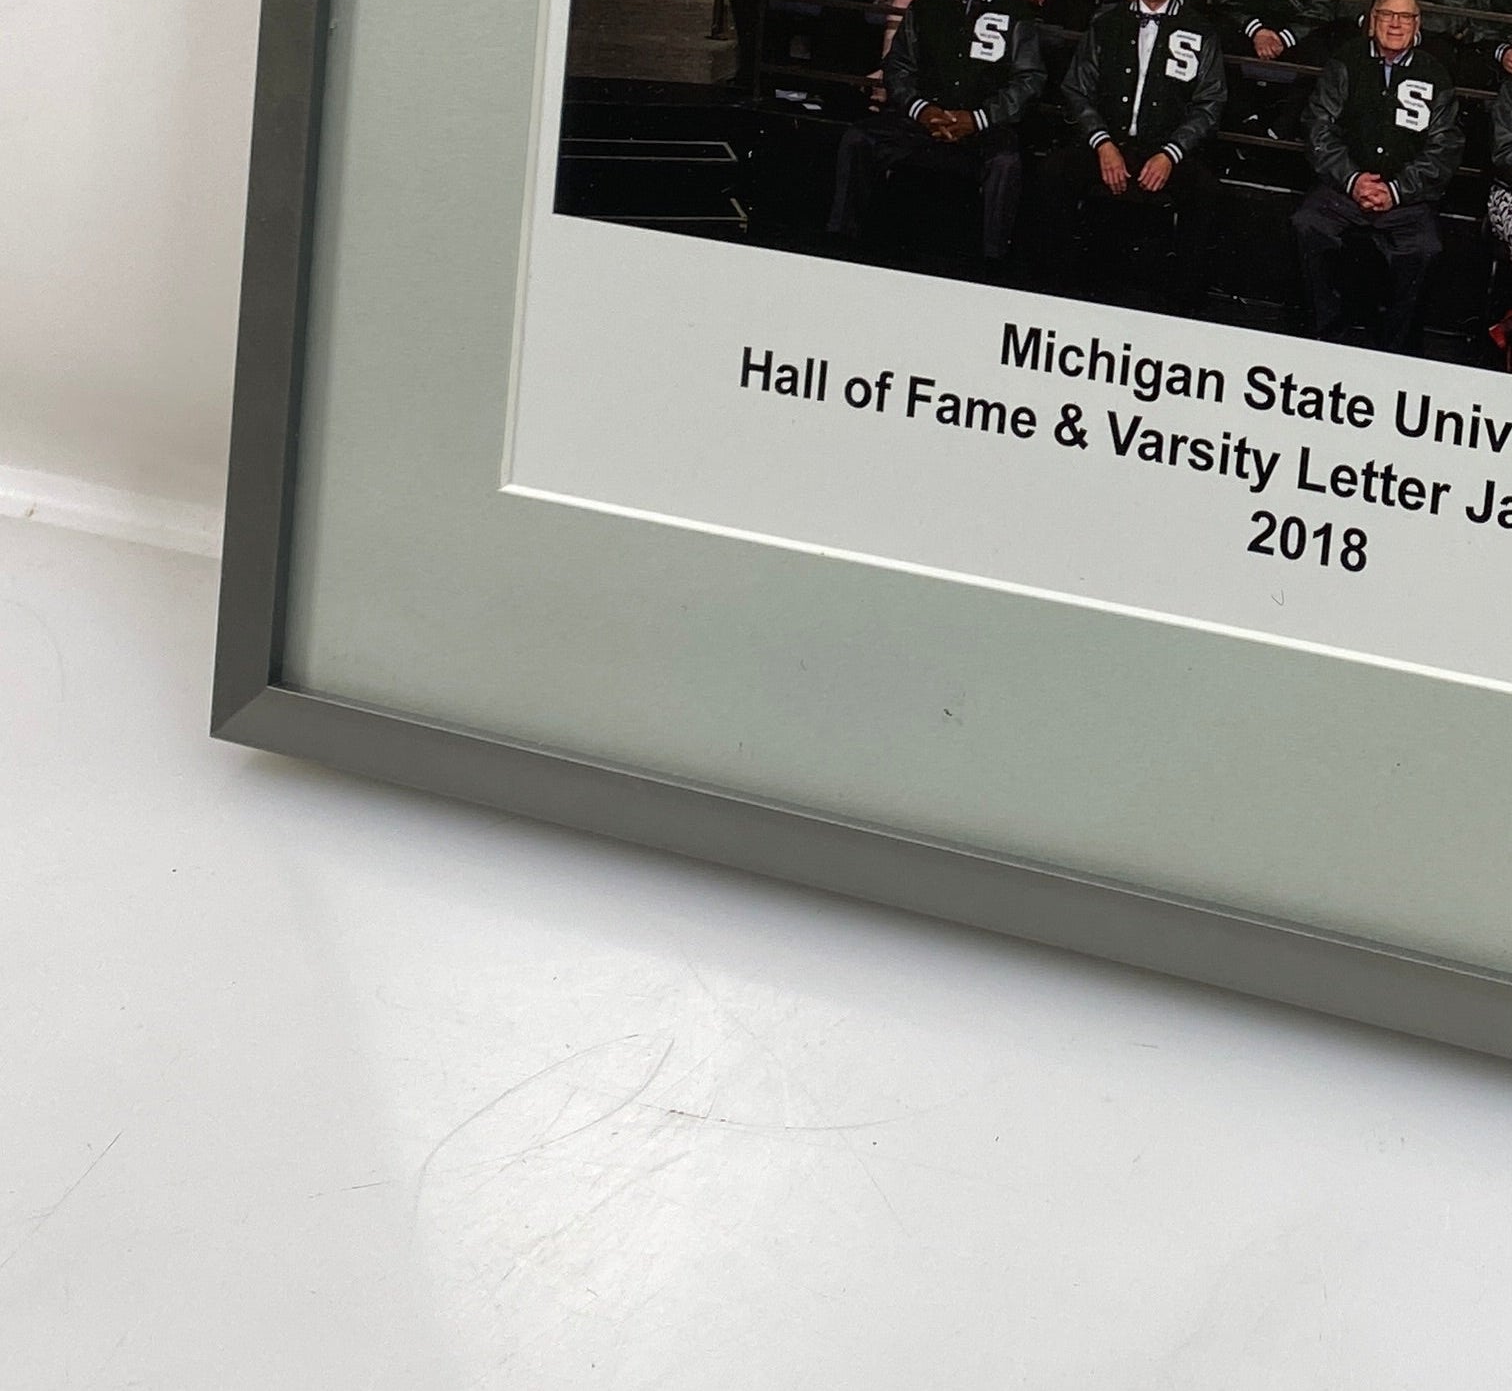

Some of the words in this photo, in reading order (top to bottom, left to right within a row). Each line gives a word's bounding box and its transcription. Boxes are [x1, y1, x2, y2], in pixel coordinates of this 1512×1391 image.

[970, 13, 1009, 62] S
[1166, 30, 1201, 81] S
[1396, 80, 1433, 131] S
[1000, 322, 1225, 403] Michigan
[1243, 365, 1375, 429] State
[740, 346, 828, 402] Hall
[844, 370, 895, 413] of
[906, 375, 1037, 439] Fame
[1054, 403, 1089, 450] &
[1107, 410, 1281, 494] Varsity
[1297, 446, 1452, 516] Letter
[1246, 510, 1368, 573] 2018
